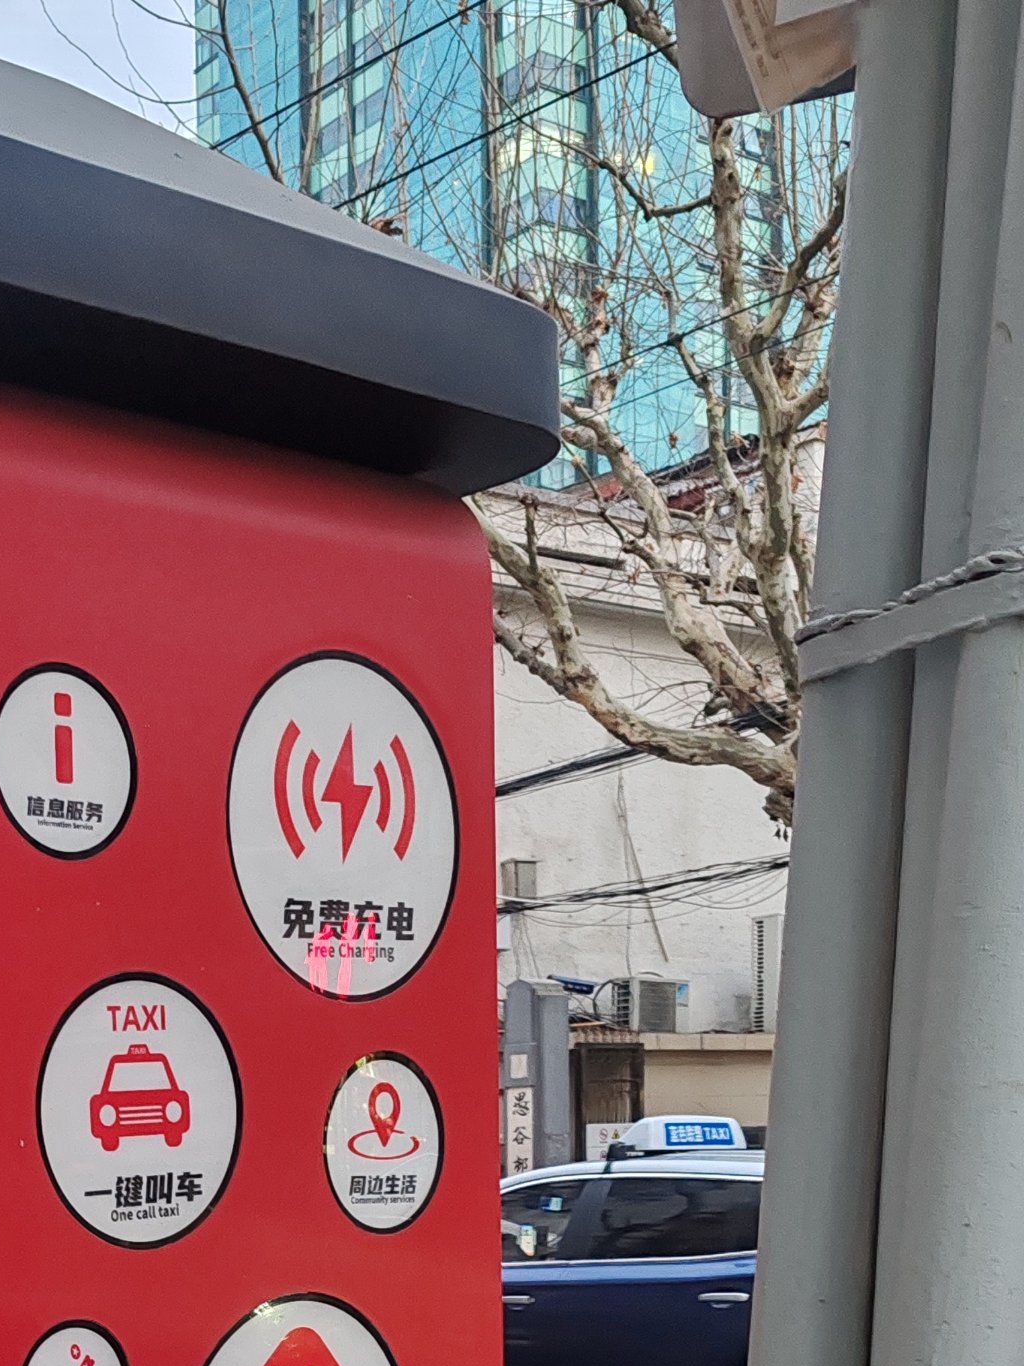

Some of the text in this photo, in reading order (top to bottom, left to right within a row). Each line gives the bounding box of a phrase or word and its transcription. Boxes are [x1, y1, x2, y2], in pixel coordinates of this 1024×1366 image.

[27, 796, 104, 823] 信息服务
[37, 819, 94, 831] Information Service
[282, 898, 415, 941] 免费充电
[307, 942, 395, 962] Free Charging
[107, 1005, 167, 1031] TAXI
[702, 1127, 730, 1140] TAXI
[84, 1171, 203, 1208] 一键叫车
[349, 1175, 417, 1196] 周边生活
[351, 1196, 415, 1205] Community services
[111, 1203, 180, 1222] One call taxi
